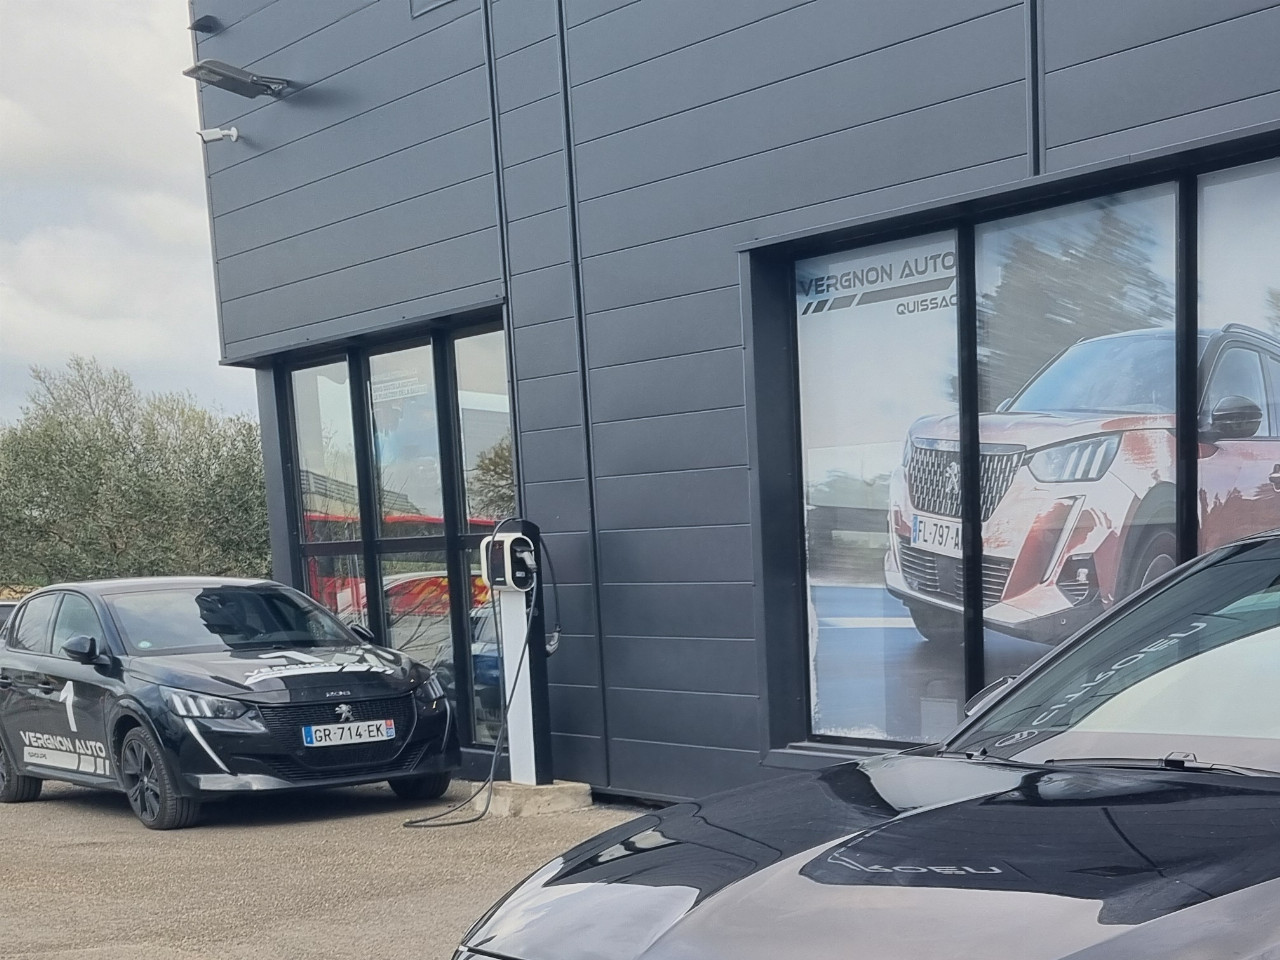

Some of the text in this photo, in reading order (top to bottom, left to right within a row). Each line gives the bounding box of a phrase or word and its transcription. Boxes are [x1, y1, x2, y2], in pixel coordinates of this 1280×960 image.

[801, 251, 956, 297] VERGNON AUTO
[917, 520, 962, 551] FL-797-A
[20, 731, 106, 758] VERGNON AUTO
[314, 723, 385, 743] GR-714-EK
